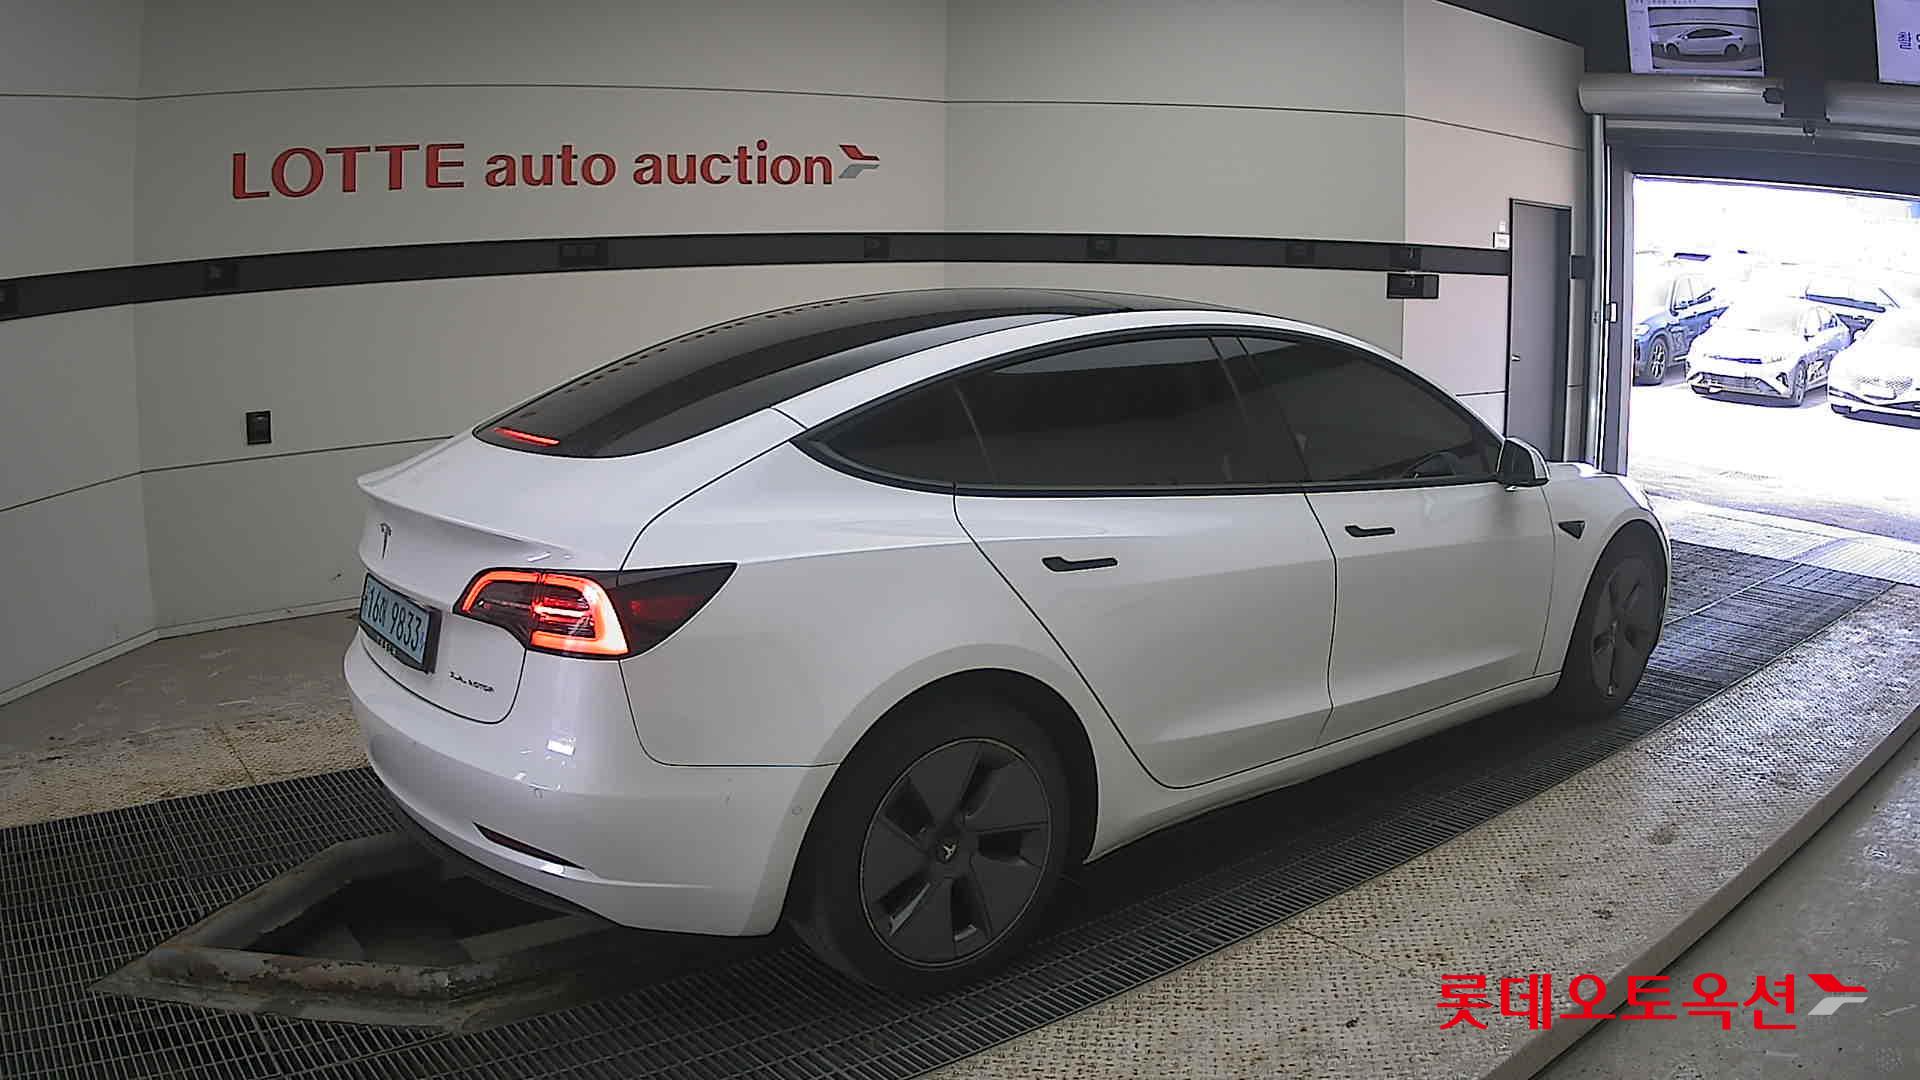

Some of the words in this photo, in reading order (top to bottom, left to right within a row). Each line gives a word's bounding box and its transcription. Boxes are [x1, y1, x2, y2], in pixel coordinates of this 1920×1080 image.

[231, 143, 465, 200] LOTTE
[484, 143, 616, 188] auto
[632, 139, 833, 187] auction
[389, 601, 422, 652] 9833
